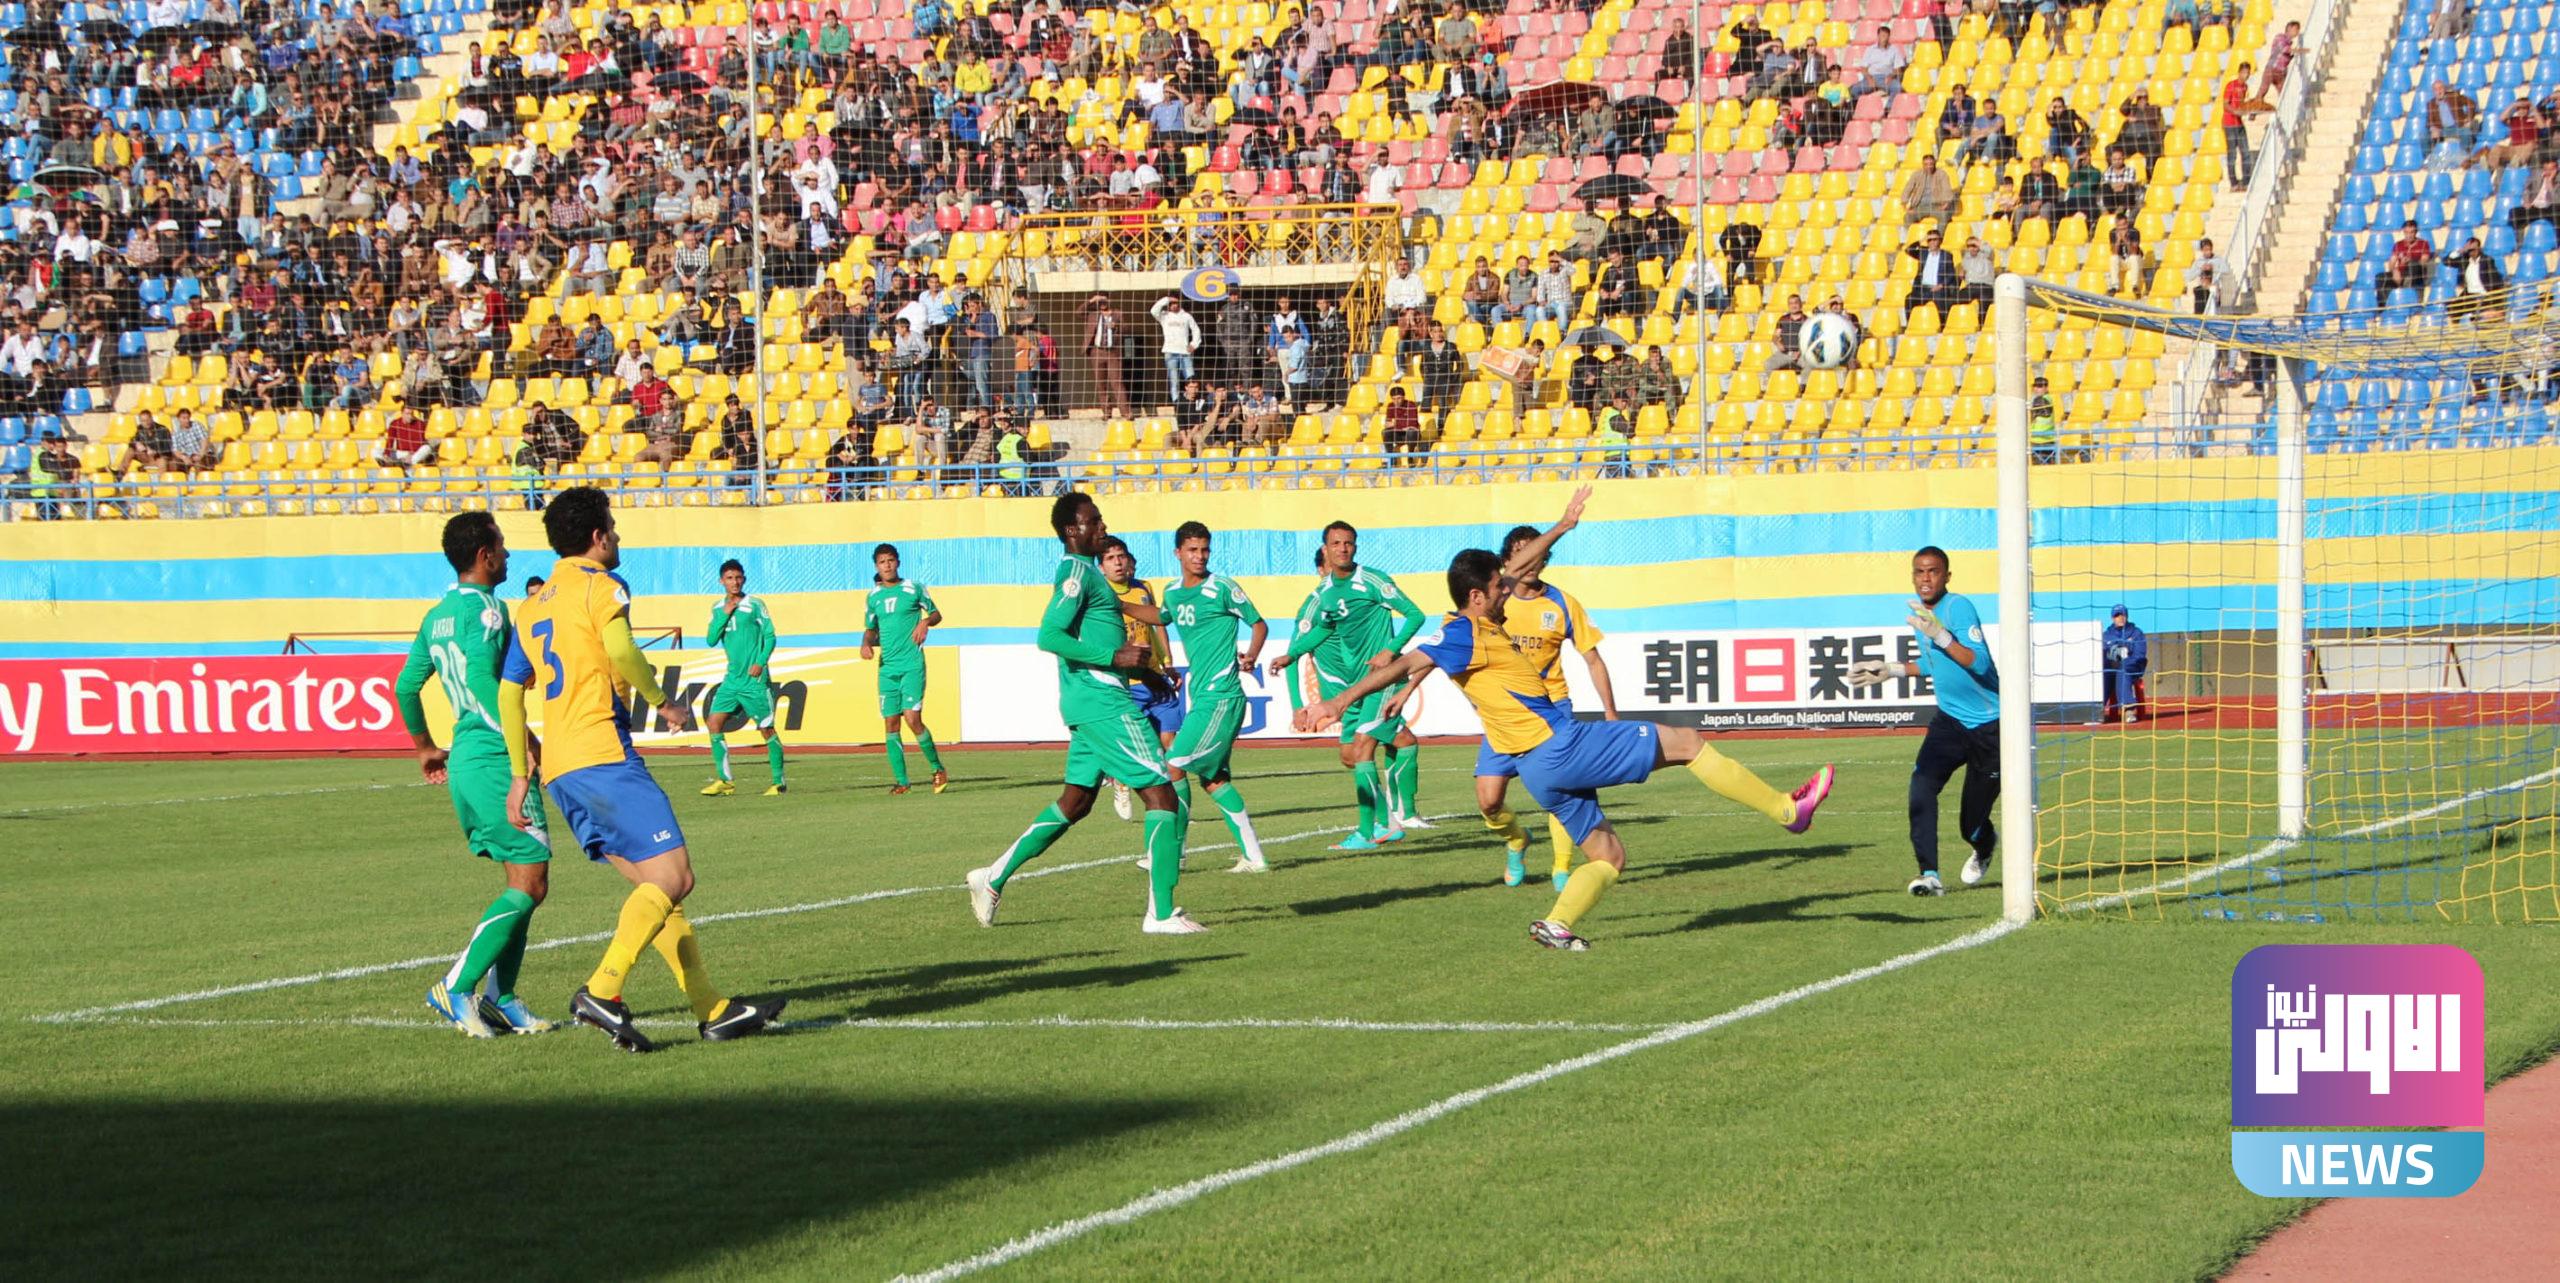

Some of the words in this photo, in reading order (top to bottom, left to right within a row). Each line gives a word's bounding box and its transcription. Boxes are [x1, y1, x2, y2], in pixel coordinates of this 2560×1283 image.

[1194, 269, 1227, 298] 6
[884, 597, 898, 614] 17
[1176, 603, 1196, 627] 26
[531, 618, 565, 701] 3
[60, 662, 394, 736] Emirates
[1701, 712, 1745, 728] Japan's
[1747, 712, 1794, 726] Leading
[1796, 711, 1845, 724] National
[1848, 709, 1915, 723] Newspaper
